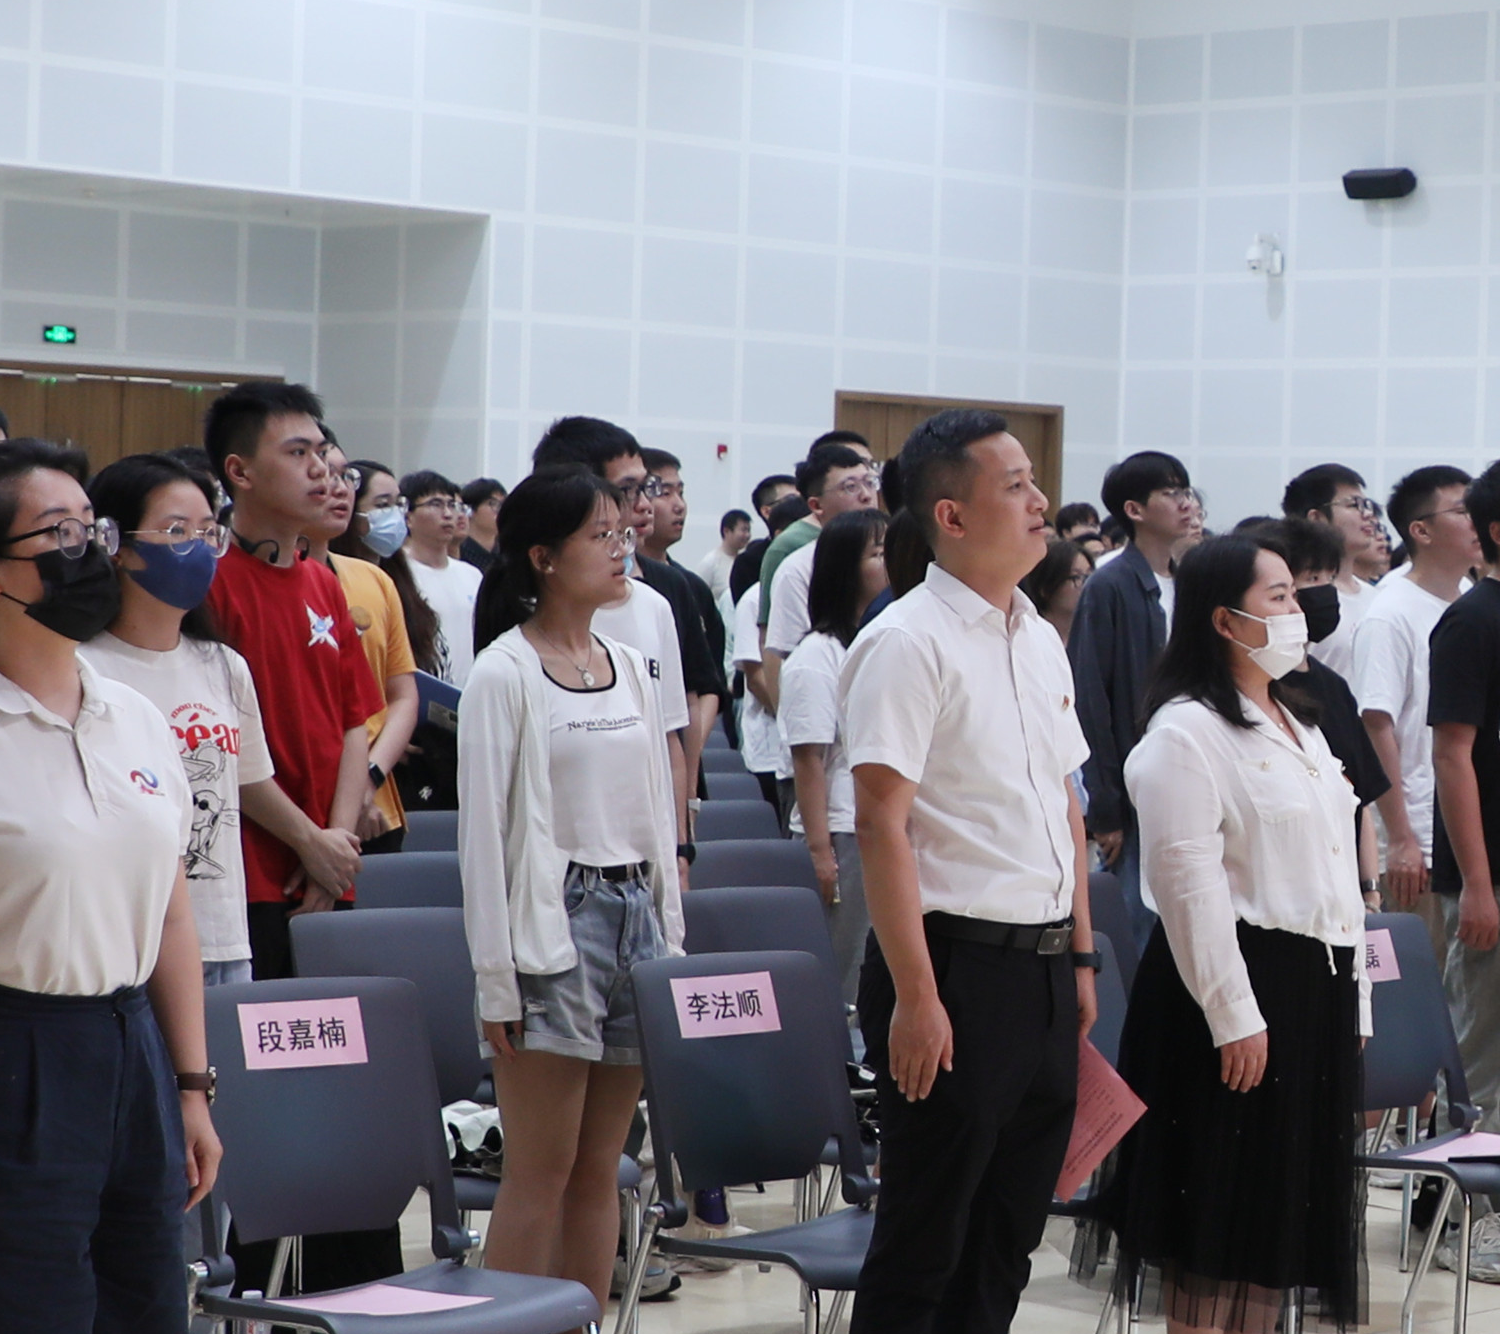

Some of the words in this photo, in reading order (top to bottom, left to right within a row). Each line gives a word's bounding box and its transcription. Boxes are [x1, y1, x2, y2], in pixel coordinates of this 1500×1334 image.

[686, 989, 763, 1022] 李法顺
[257, 1017, 347, 1053] 段嘉楠
